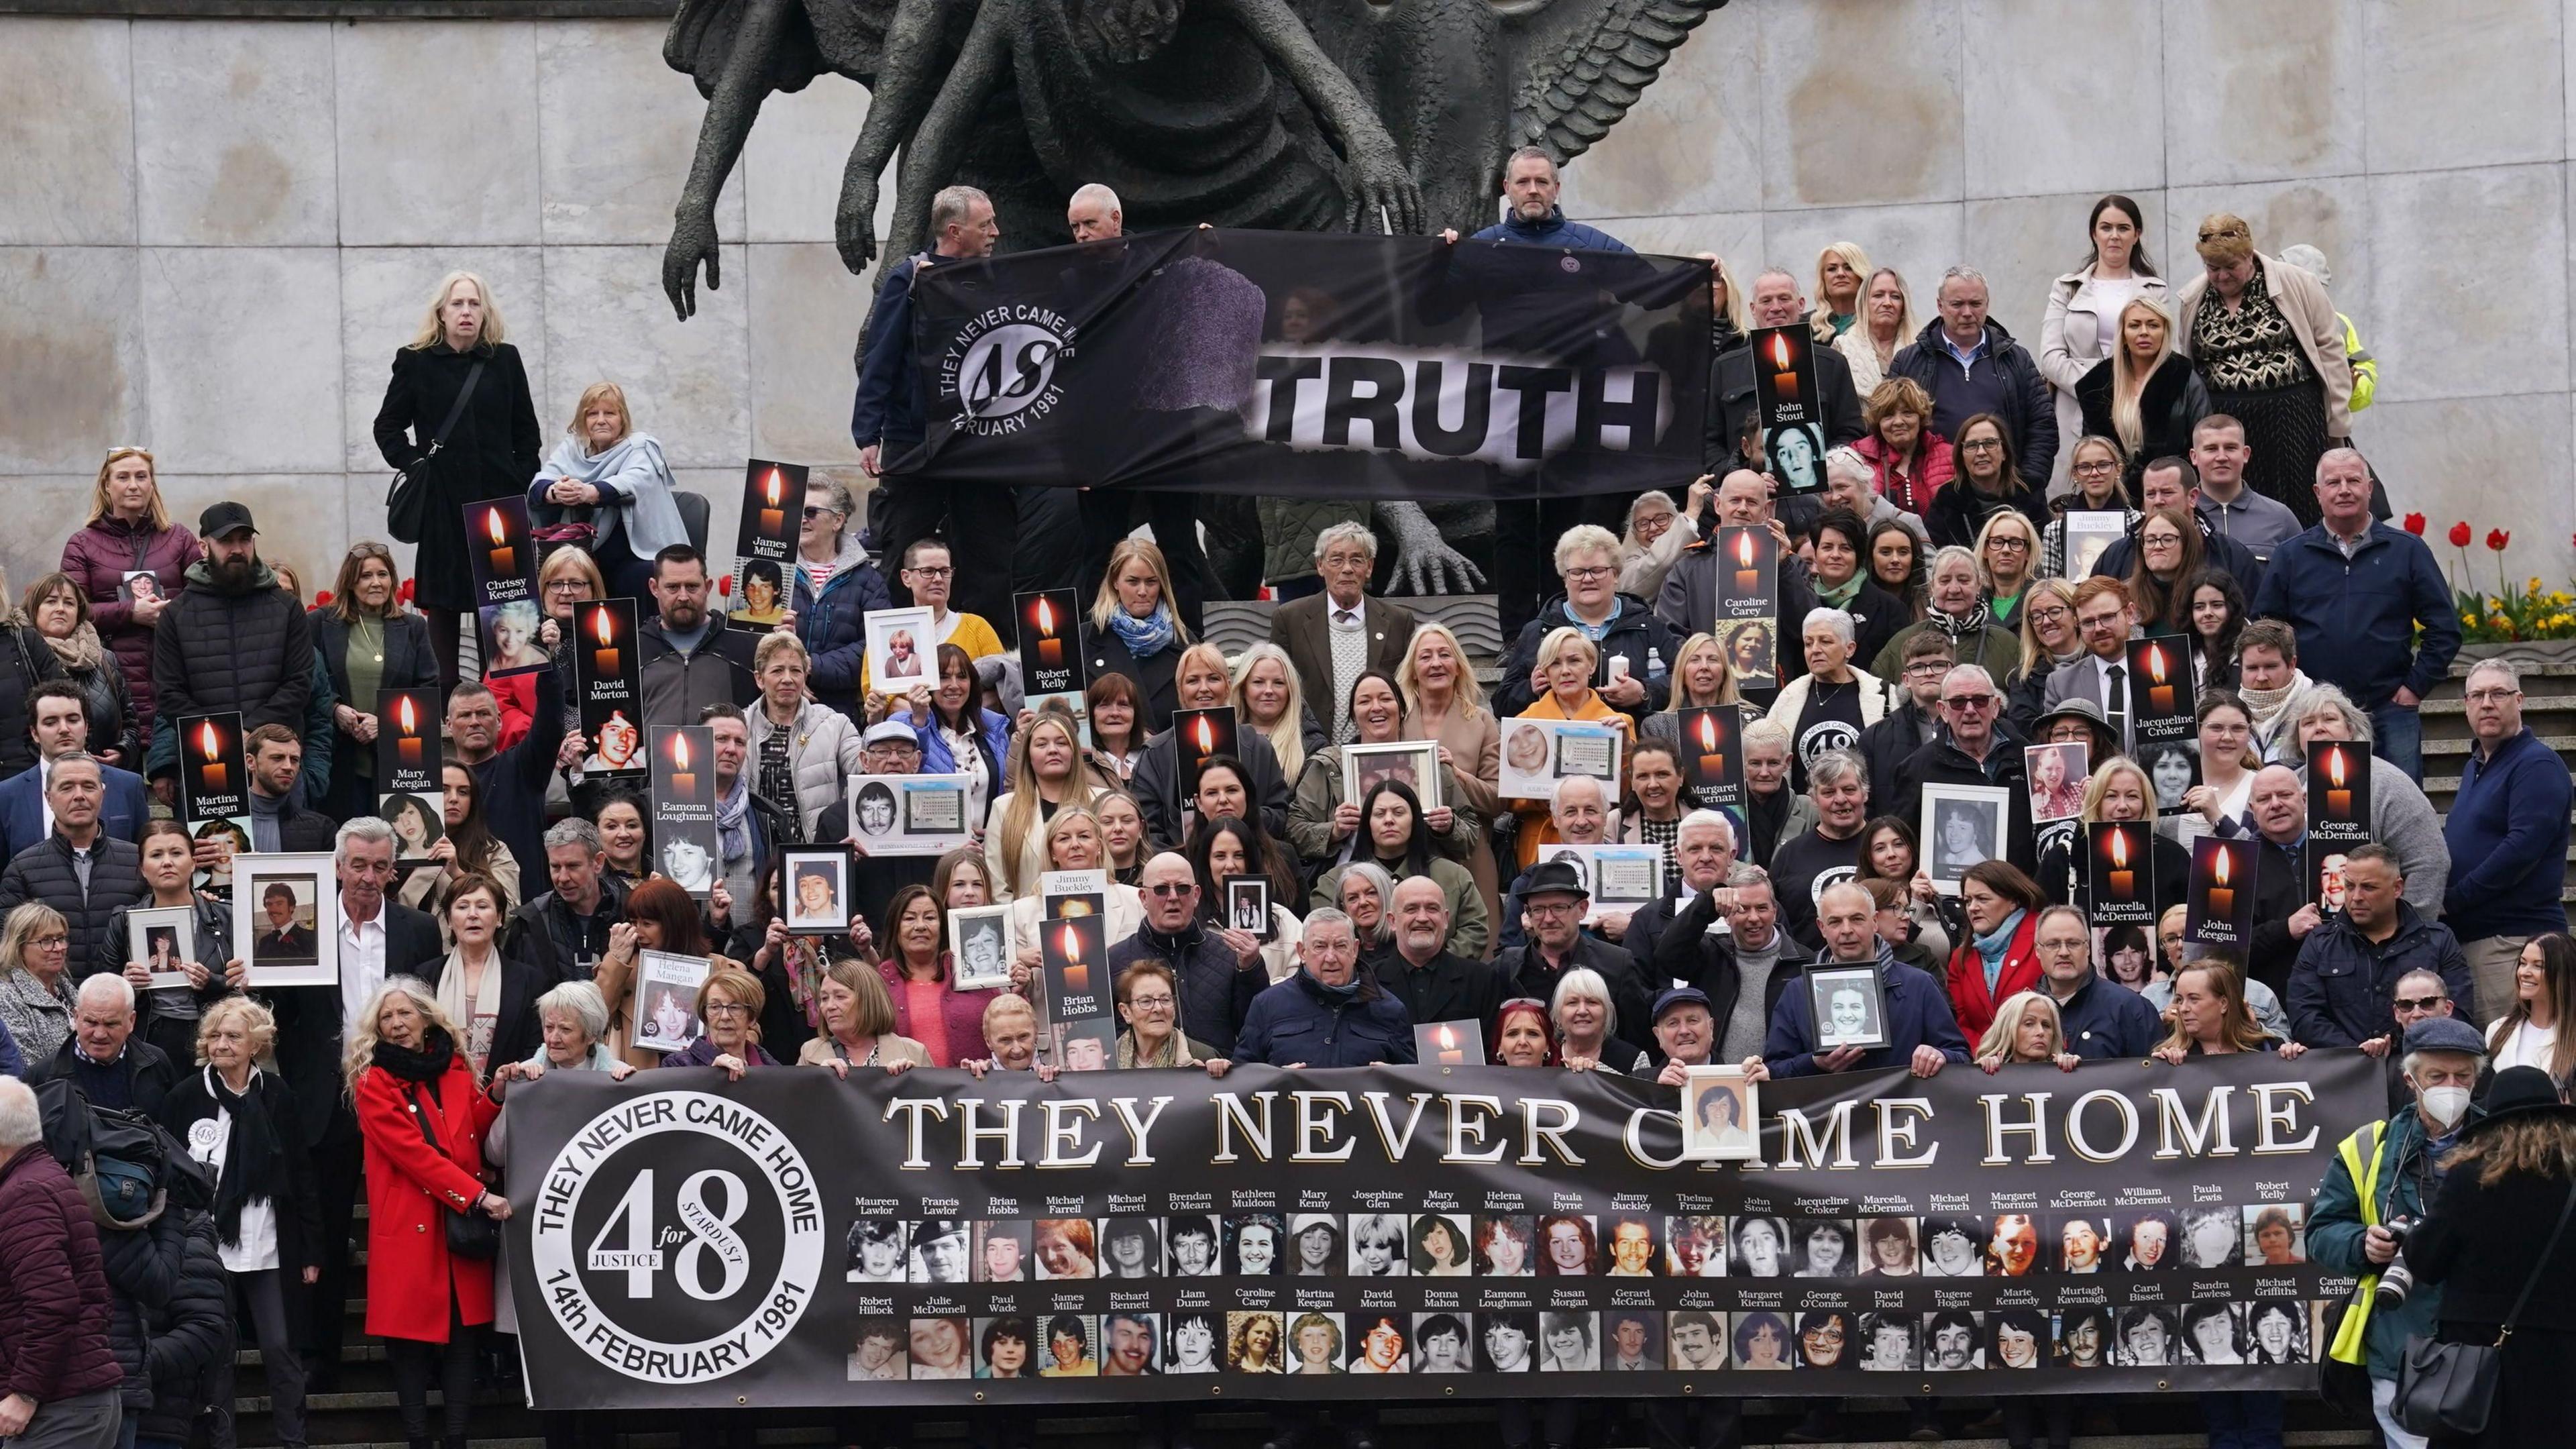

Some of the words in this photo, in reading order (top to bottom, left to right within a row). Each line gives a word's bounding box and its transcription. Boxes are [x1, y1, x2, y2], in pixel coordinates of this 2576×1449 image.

[941, 347, 961, 396] THEY
[957, 306, 1011, 346] NEVER
[1016, 305, 1066, 332] CAME
[1030, 384, 1064, 419] 1981
[1256, 356, 1660, 459] TRUTH
[1776, 403, 1802, 413] John
[1776, 413, 1804, 421] Stout
[753, 537, 786, 547] James
[754, 547, 786, 557] Millar
[486, 578, 526, 590] Chrissy
[488, 588, 527, 600] Keegan
[1725, 598, 1768, 607] Caroline
[1731, 608, 1760, 616] Carey
[1036, 669, 1070, 679] Robert
[594, 680, 624, 690] David
[1041, 678, 1066, 689] Kelly
[591, 691, 629, 700] Morton
[2136, 716, 2194, 730] Jacqueline
[2147, 727, 2184, 736] Croker
[1801, 736, 1809, 751] THEY
[1809, 723, 1830, 735] NEVER
[1832, 723, 1850, 732] CAME
[397, 769, 425, 779] Mary
[392, 777, 431, 790] Keegan
[1691, 784, 1737, 794] Margaret
[196, 795, 238, 805] Martina
[197, 805, 237, 816] Keegan
[663, 802, 706, 811] Eamonn
[657, 811, 712, 822] Loughman
[2320, 820, 2358, 833] George
[2309, 830, 2369, 840] McDermott
[1056, 875, 1090, 884] Jimmy
[1054, 883, 1093, 892] Buckley
[2100, 902, 2145, 911] Marcella
[2093, 912, 2153, 922] McDermott
[2204, 920, 2231, 931] John
[2198, 929, 2237, 942] Keegan
[658, 960, 690, 973] Helena
[655, 969, 694, 984] Mangan
[1064, 996, 1094, 1005] Brian
[1063, 1005, 1097, 1015] Hobbs
[883, 1098, 1173, 1171] THEY
[1214, 1091, 1585, 1166] NEVER
[1623, 1104, 1939, 1171] CME
[1977, 1082, 2319, 1165] HOME
[198, 1130, 215, 1139] 48
[539, 1155, 583, 1235] THEY
[577, 1099, 677, 1160] NEVER
[686, 1099, 771, 1152] CAME
[765, 1145, 818, 1235] HOME
[2123, 1187, 2161, 1196] William
[2193, 1184, 2222, 1193] Paula
[1108, 1194, 1146, 1203] Michael
[1169, 1192, 1212, 1201] Brendan
[1232, 1190, 1275, 1198] Kathleen
[1303, 1190, 1327, 1201] Mary
[1352, 1191, 1403, 1202] Josephine
[1428, 1191, 1453, 1201] Mary
[1487, 1191, 1521, 1199] Helena
[1554, 1193, 1582, 1201] Paula
[1611, 1193, 1648, 1203] Jimmy
[1930, 1193, 1969, 1202] Michael
[1992, 1192, 2036, 1202] Margaret
[2194, 1193, 2222, 1201] Lewis
[2261, 1190, 2285, 1200] Kelly
[922, 1197, 959, 1205] Francis
[1046, 1195, 1083, 1204] Michael
[1232, 1199, 1275, 1207] Muldoon
[1366, 1199, 1389, 1208] Glen
[1676, 1194, 1713, 1204] Thelma
[1794, 1196, 1849, 1205] Jacqueline
[1864, 1195, 1907, 1203] Marcella
[2051, 1198, 2106, 1208] McDermott
[2115, 1195, 2171, 1205] McDermott
[1170, 1201, 1211, 1210] O'Meara
[1299, 1198, 1330, 1210] Kenny
[1424, 1199, 1458, 1210] Keegan
[1485, 1201, 1524, 1211] Mangan
[1554, 1201, 1582, 1211] Byrne
[1611, 1201, 1651, 1212] Buckley
[1745, 1204, 1771, 1212] Stout
[1858, 1204, 1914, 1213] McDermott
[1931, 1203, 1969, 1211] Ffrench
[1990, 1200, 2037, 1209] Thornton
[861, 1206, 894, 1214] Lawlor
[924, 1206, 957, 1214] Lawlor
[988, 1206, 1018, 1214] Hobbs
[1050, 1205, 1081, 1214] Farrell
[1805, 1205, 1839, 1214] Croker
[656, 1226, 688, 1248] for
[682, 1202, 743, 1265] STARDUST
[592, 1254, 658, 1267] JUSTICE
[2193, 1281, 2229, 1289] Sandra
[2257, 1278, 2295, 1287] Michael
[2058, 1286, 2103, 1295] Murtagh
[2133, 1283, 2159, 1292] Carol
[2255, 1287, 2297, 1295] Griffiths
[1051, 1293, 1084, 1301] James
[1111, 1291, 1148, 1300] Richard
[1236, 1289, 1275, 1297] Caroline
[1296, 1289, 1334, 1297] Martina
[1364, 1290, 1392, 1298] David
[1554, 1289, 1585, 1297] Susan
[1683, 1290, 1709, 1298] John
[1739, 1291, 1782, 1301] Margaret
[1807, 1291, 1841, 1302] George
[1875, 1291, 1903, 1299] David
[1935, 1290, 1972, 1299] Eugene
[2004, 1289, 2033, 1297] Marie
[2130, 1293, 2163, 1301] Bissett
[2192, 1290, 2231, 1298] Lawless
[860, 1297, 892, 1305] Robert
[926, 1297, 951, 1305] Julie
[992, 1295, 1014, 1303] Paul
[1177, 1299, 1210, 1307] Dunne
[1242, 1297, 1269, 1307] Carey
[1425, 1299, 1458, 1307] Mahon
[1551, 1298, 1588, 1307] Morgan
[1611, 1297, 1654, 1305] McGrath
[1680, 1299, 1714, 1308] Colgan
[1741, 1298, 1780, 1307] Kiernan
[1801, 1299, 1848, 1307] O'Connor
[1876, 1299, 1902, 1307] Flood
[1937, 1298, 1969, 1308] Hogan
[1996, 1296, 2039, 1306] Kennedy
[2058, 1295, 2107, 1304] Kavanagh
[989, 1304, 1016, 1312] Wade
[1298, 1299, 1332, 1309] Keegan
[1479, 1299, 1532, 1309] Loughman
[859, 1306, 894, 1314] Hillock
[913, 1305, 965, 1313] McDonnell
[547, 1269, 588, 1333] 14th
[586, 1325, 750, 1379] FEBRUARY
[755, 1281, 805, 1340] 1981
